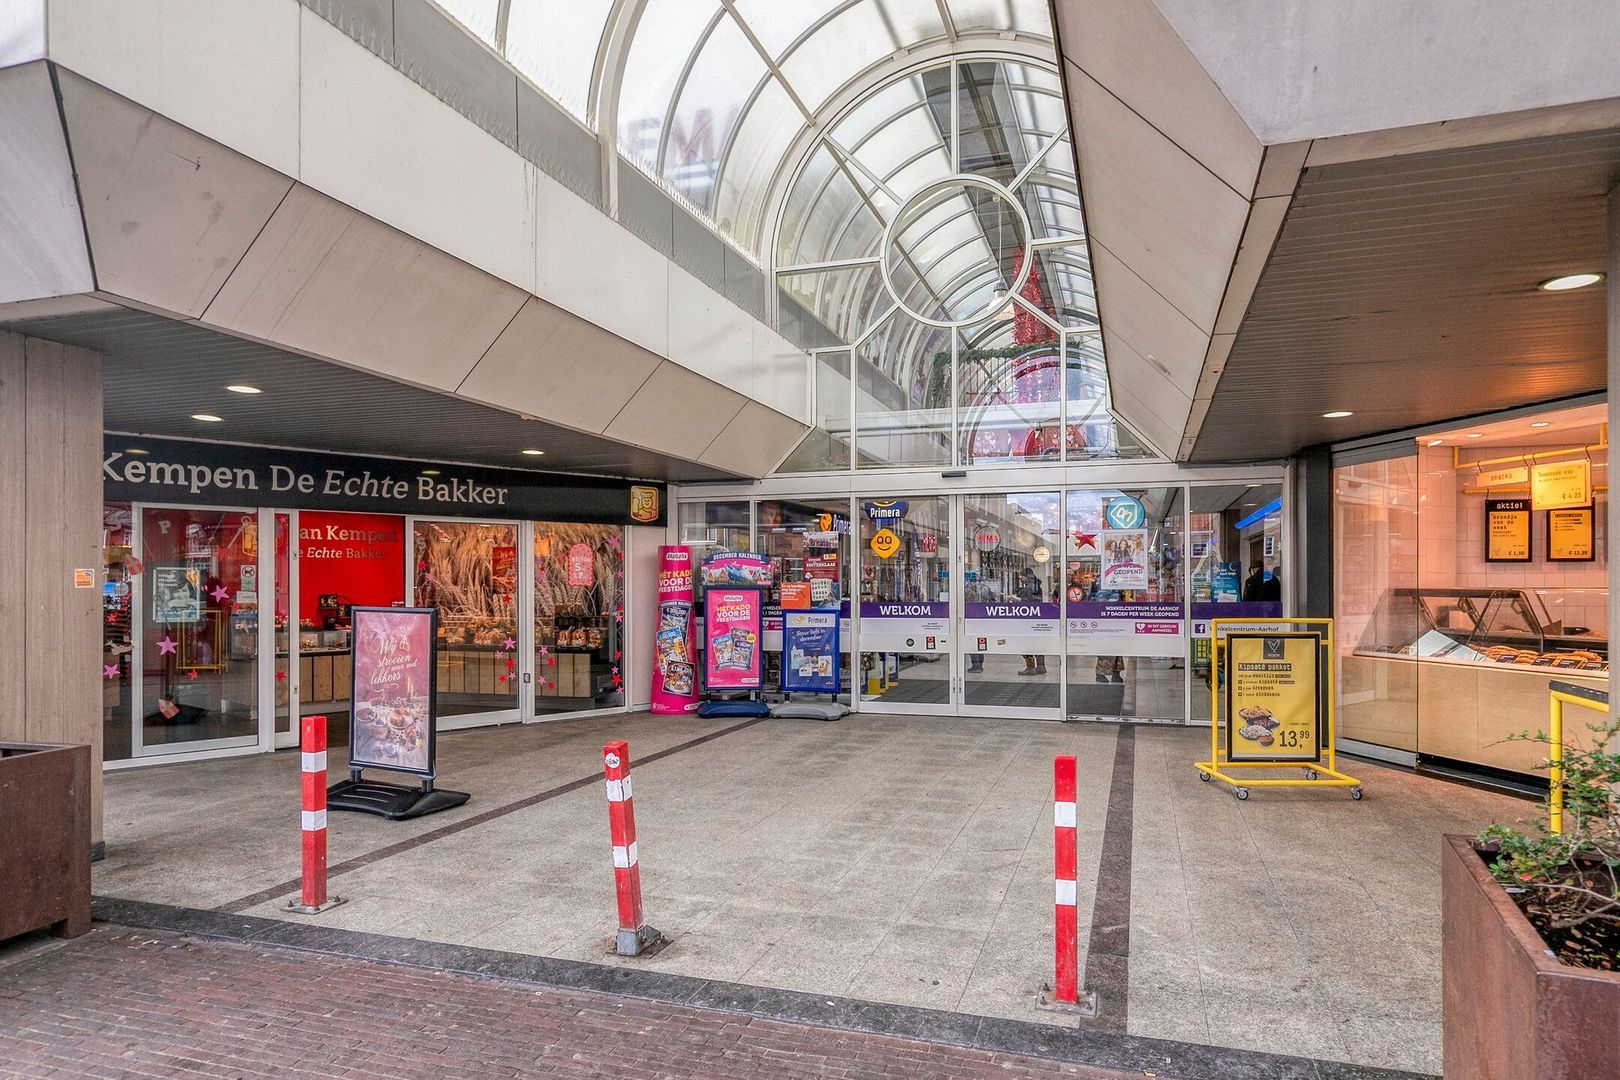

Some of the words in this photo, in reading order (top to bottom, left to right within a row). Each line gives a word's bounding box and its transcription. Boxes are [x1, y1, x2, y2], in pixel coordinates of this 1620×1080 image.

[103, 452, 259, 494] Kempen
[270, 464, 315, 494] De
[323, 470, 409, 499] Echte
[416, 475, 508, 506] Bakker
[1490, 473, 1513, 482] snacks
[870, 507, 900, 518] Primera
[325, 525, 397, 545] Kempen
[306, 546, 343, 558] Echte
[713, 552, 737, 560] DECEMBER
[739, 552, 762, 560] KALENDER
[659, 578, 683, 587] VOOR
[731, 603, 750, 611] KADO
[879, 606, 932, 616] WELKOM
[985, 606, 1041, 617] WELKOM
[716, 615, 751, 623] FEESTDAGEN
[808, 616, 828, 624] Primera
[1239, 663, 1266, 671] Kipsaté
[370, 668, 401, 685] lekkers
[1279, 730, 1310, 749] 13,99
